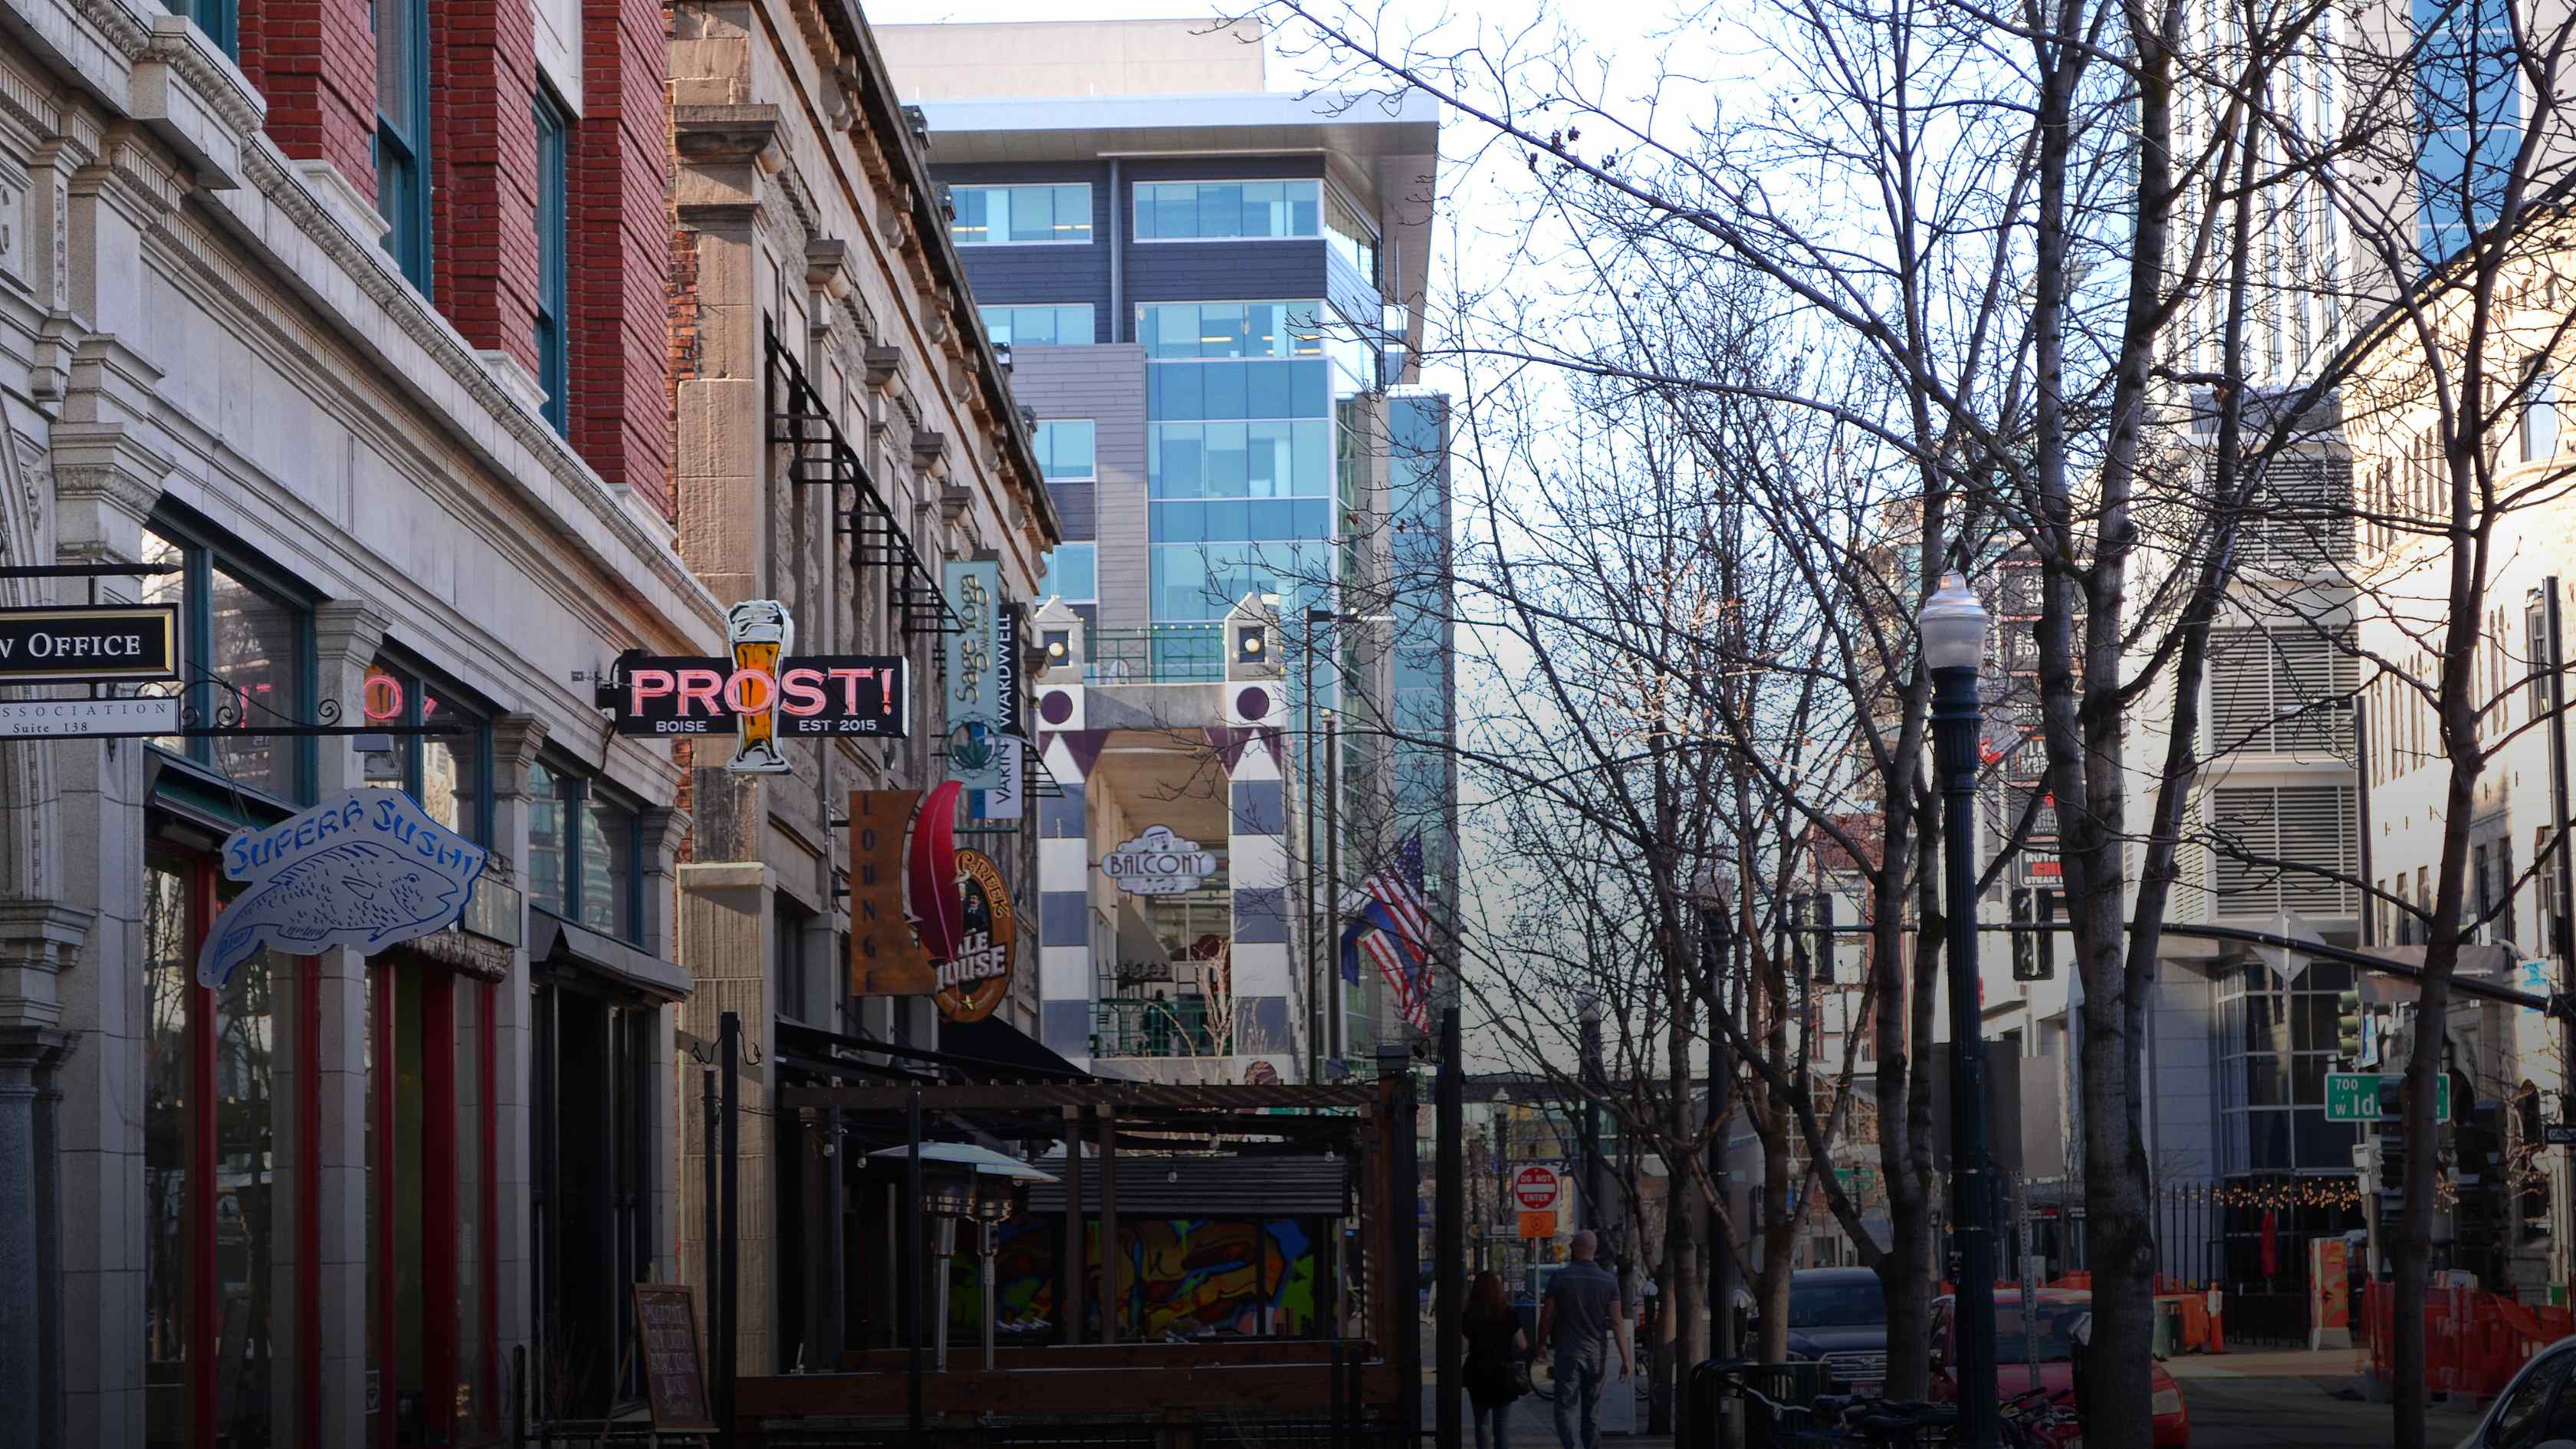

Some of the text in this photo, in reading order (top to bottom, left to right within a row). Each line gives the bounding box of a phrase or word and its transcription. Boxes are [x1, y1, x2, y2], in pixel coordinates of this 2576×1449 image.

[955, 573, 989, 705] Sage Yoga
[997, 613, 1012, 728] WARDWELL
[629, 667, 894, 716] PROST!
[13, 722, 88, 733] Suite 138
[656, 719, 877, 733] BOISE EST 2015
[372, 799, 473, 876] SUSHI
[1110, 855, 1204, 874] BALCONY
[2334, 1078, 2359, 1091] 700
[2334, 1103, 2347, 1116] W
[1521, 1175, 1552, 1183] DO NOT
[1523, 1194, 1549, 1202] ENTER
